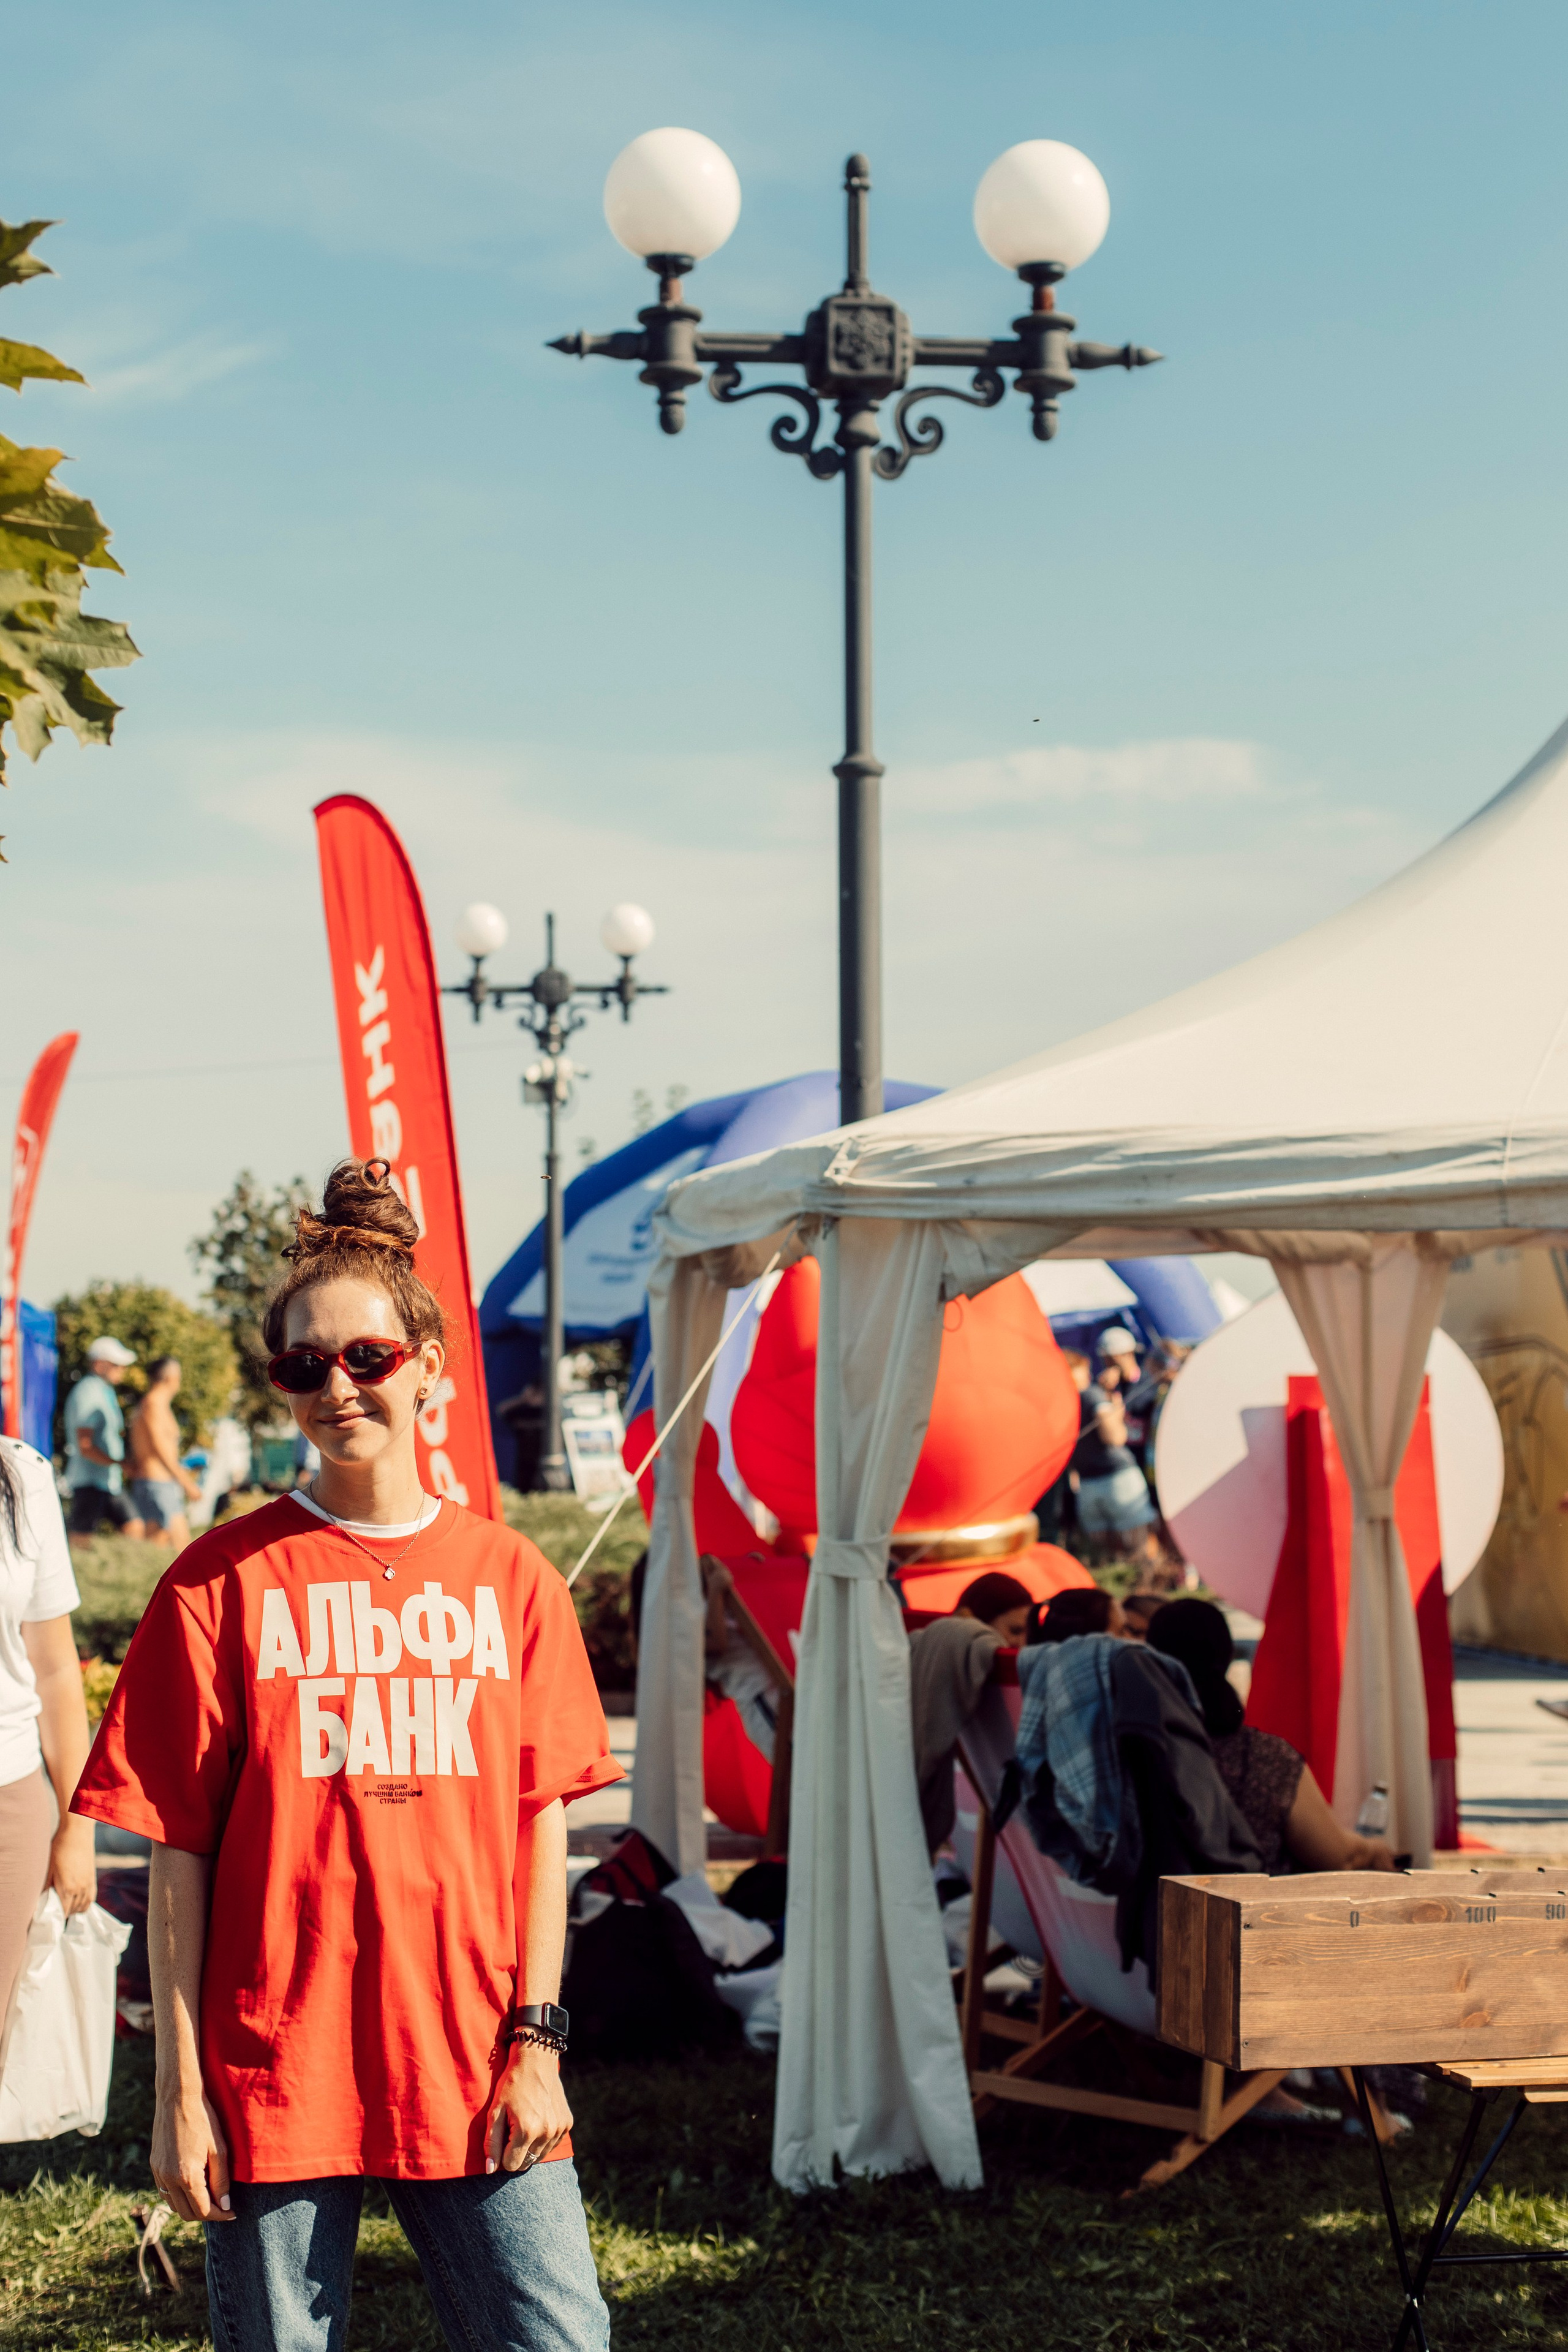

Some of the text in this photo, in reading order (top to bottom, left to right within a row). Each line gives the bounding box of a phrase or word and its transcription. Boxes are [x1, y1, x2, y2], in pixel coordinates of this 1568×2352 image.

[257, 1580, 510, 1680] АЛЬФА
[298, 1676, 480, 1778] БАНК
[1350, 1904, 1567, 1928] 0 100 90
